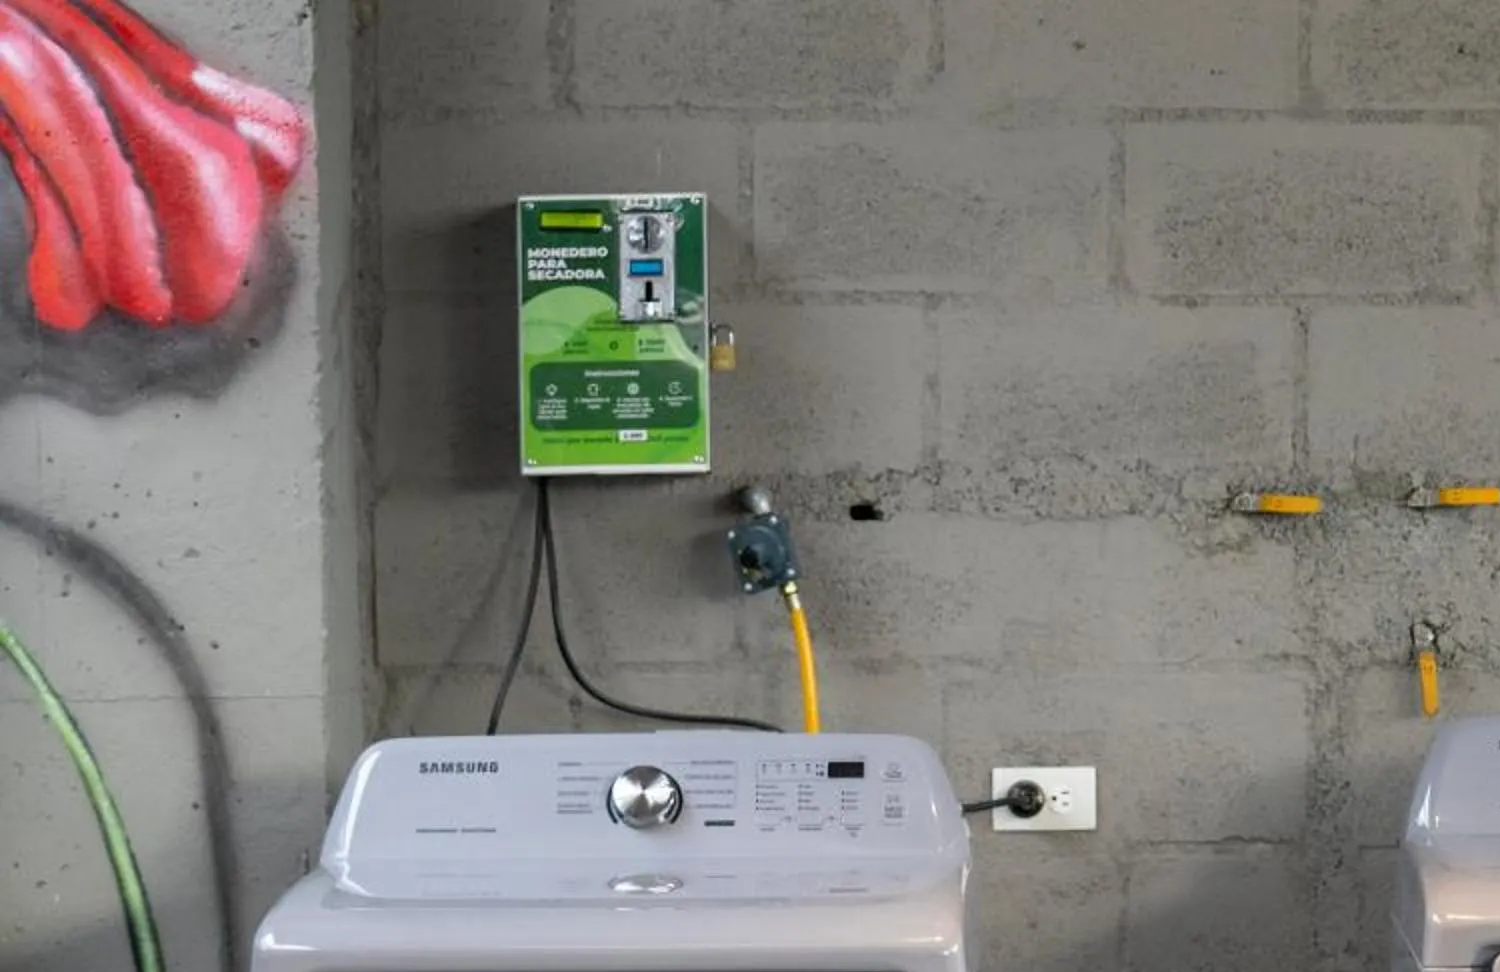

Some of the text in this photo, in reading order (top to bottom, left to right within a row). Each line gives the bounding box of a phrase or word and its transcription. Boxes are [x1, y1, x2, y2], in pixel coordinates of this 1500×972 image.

[527, 246, 609, 259] MONEDERO
[527, 259, 567, 270] PARA
[527, 268, 606, 281] SECADORA
[418, 761, 499, 774] SAMSUNG
